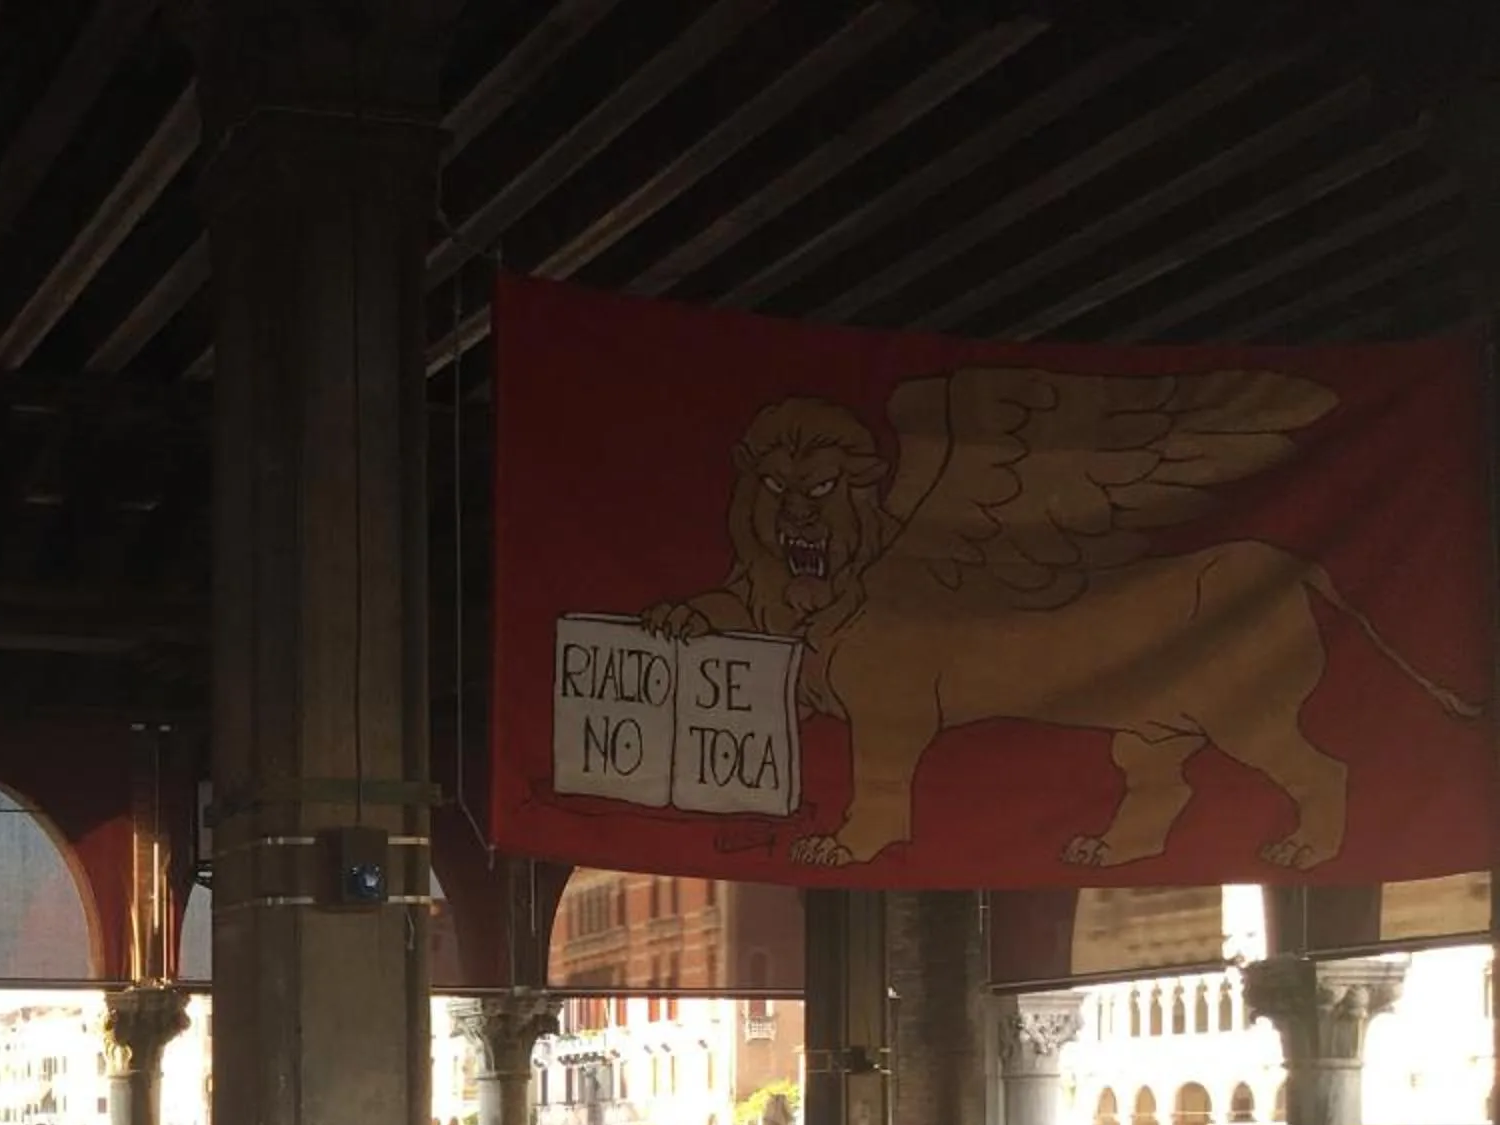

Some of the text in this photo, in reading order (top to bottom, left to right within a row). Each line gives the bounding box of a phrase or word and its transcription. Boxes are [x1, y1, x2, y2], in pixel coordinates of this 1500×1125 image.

[561, 644, 671, 706] RIALTO
[696, 658, 751, 711] SE
[583, 714, 643, 776] NO
[689, 726, 779, 790] TOCA
